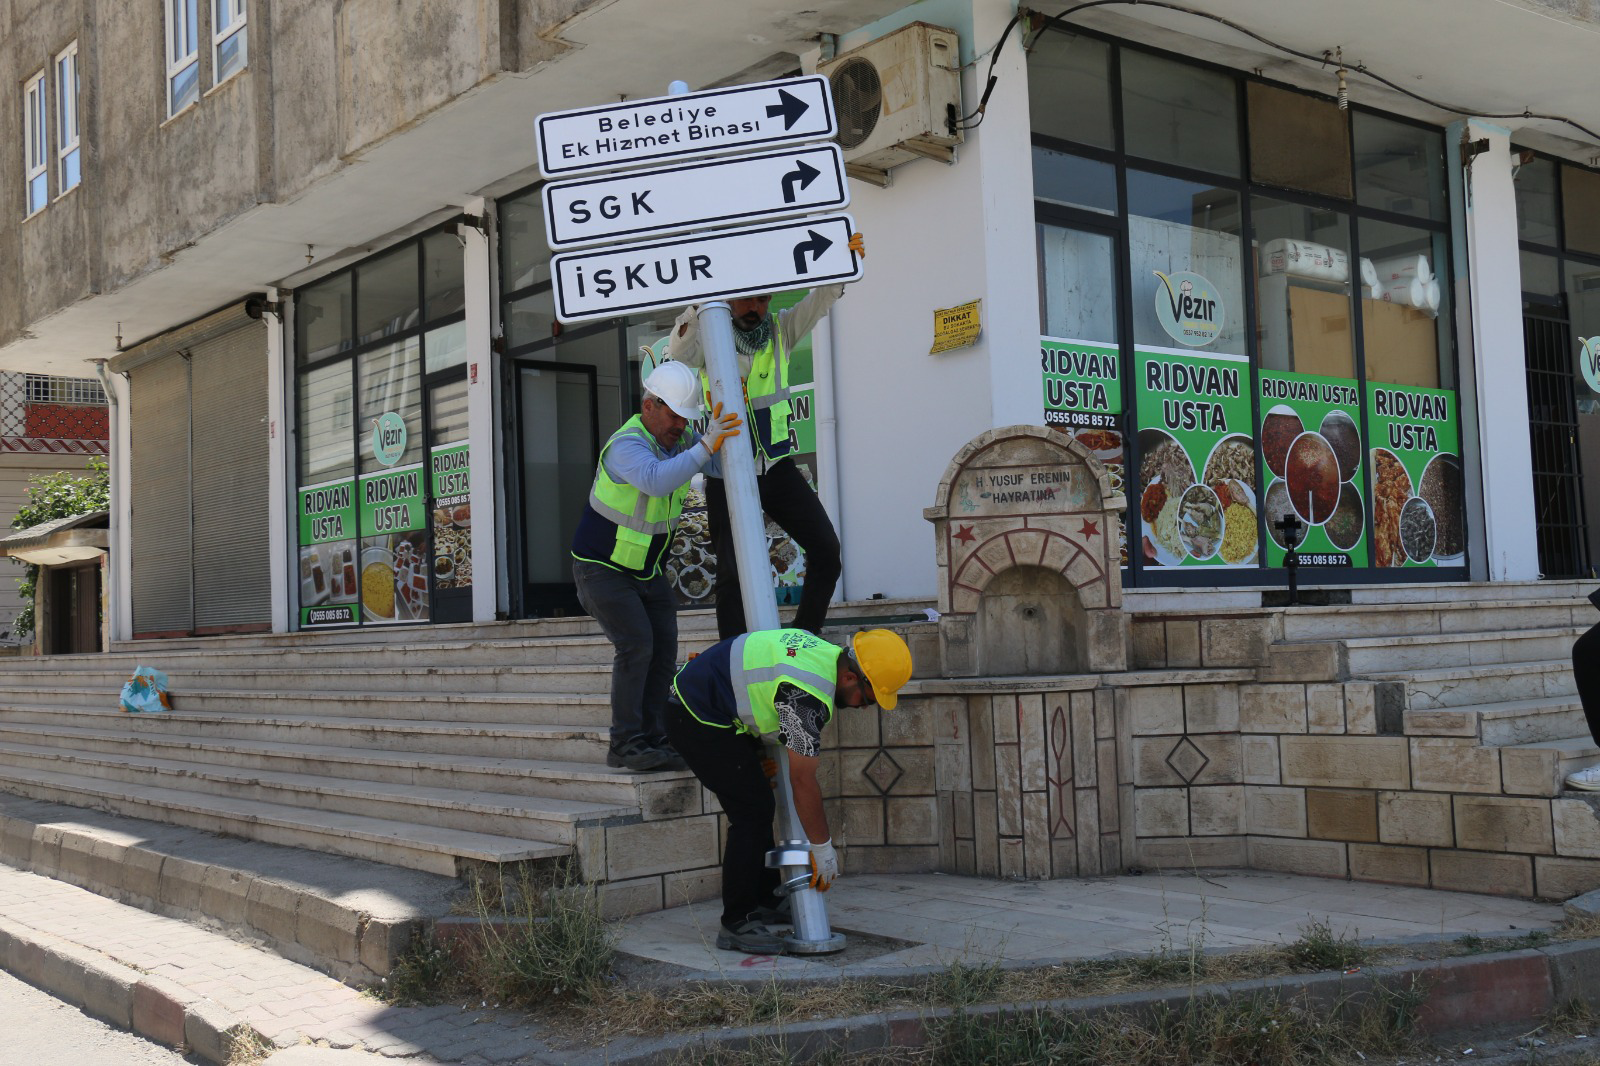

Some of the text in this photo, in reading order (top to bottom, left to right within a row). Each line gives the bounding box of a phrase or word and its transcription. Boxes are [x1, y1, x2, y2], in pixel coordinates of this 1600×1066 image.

[598, 104, 717, 133] Belediye
[562, 119, 760, 159] Ek Hizmet Binası
[569, 189, 655, 224] SGK
[576, 253, 713, 298] İŞKUR
[1153, 270, 1216, 323] Vezir
[1041, 347, 1117, 380] RIDVAN
[1145, 360, 1239, 398] RIDVAN
[1046, 378, 1109, 411] USTA
[1262, 377, 1359, 406] RIDVAN USTA
[1374, 388, 1448, 421] RIDVAN
[1046, 411, 1116, 427] 0555 085 85 72
[1164, 399, 1228, 433] USTA
[373, 419, 402, 451] Vezir
[1388, 422, 1438, 451] USTA
[366, 471, 418, 504] RIDVAN
[438, 471, 470, 495] USTA
[990, 473, 1024, 487] YUSUF
[1030, 471, 1070, 485] ERENIN
[305, 484, 350, 516] RIDVAN
[451, 496, 461, 505] 085
[461, 495, 467, 503] 85
[312, 514, 343, 541] USTA
[374, 504, 411, 532] USTA
[1298, 555, 1347, 565] 555 085 85 72
[313, 609, 350, 621] 0555 085 85 72
